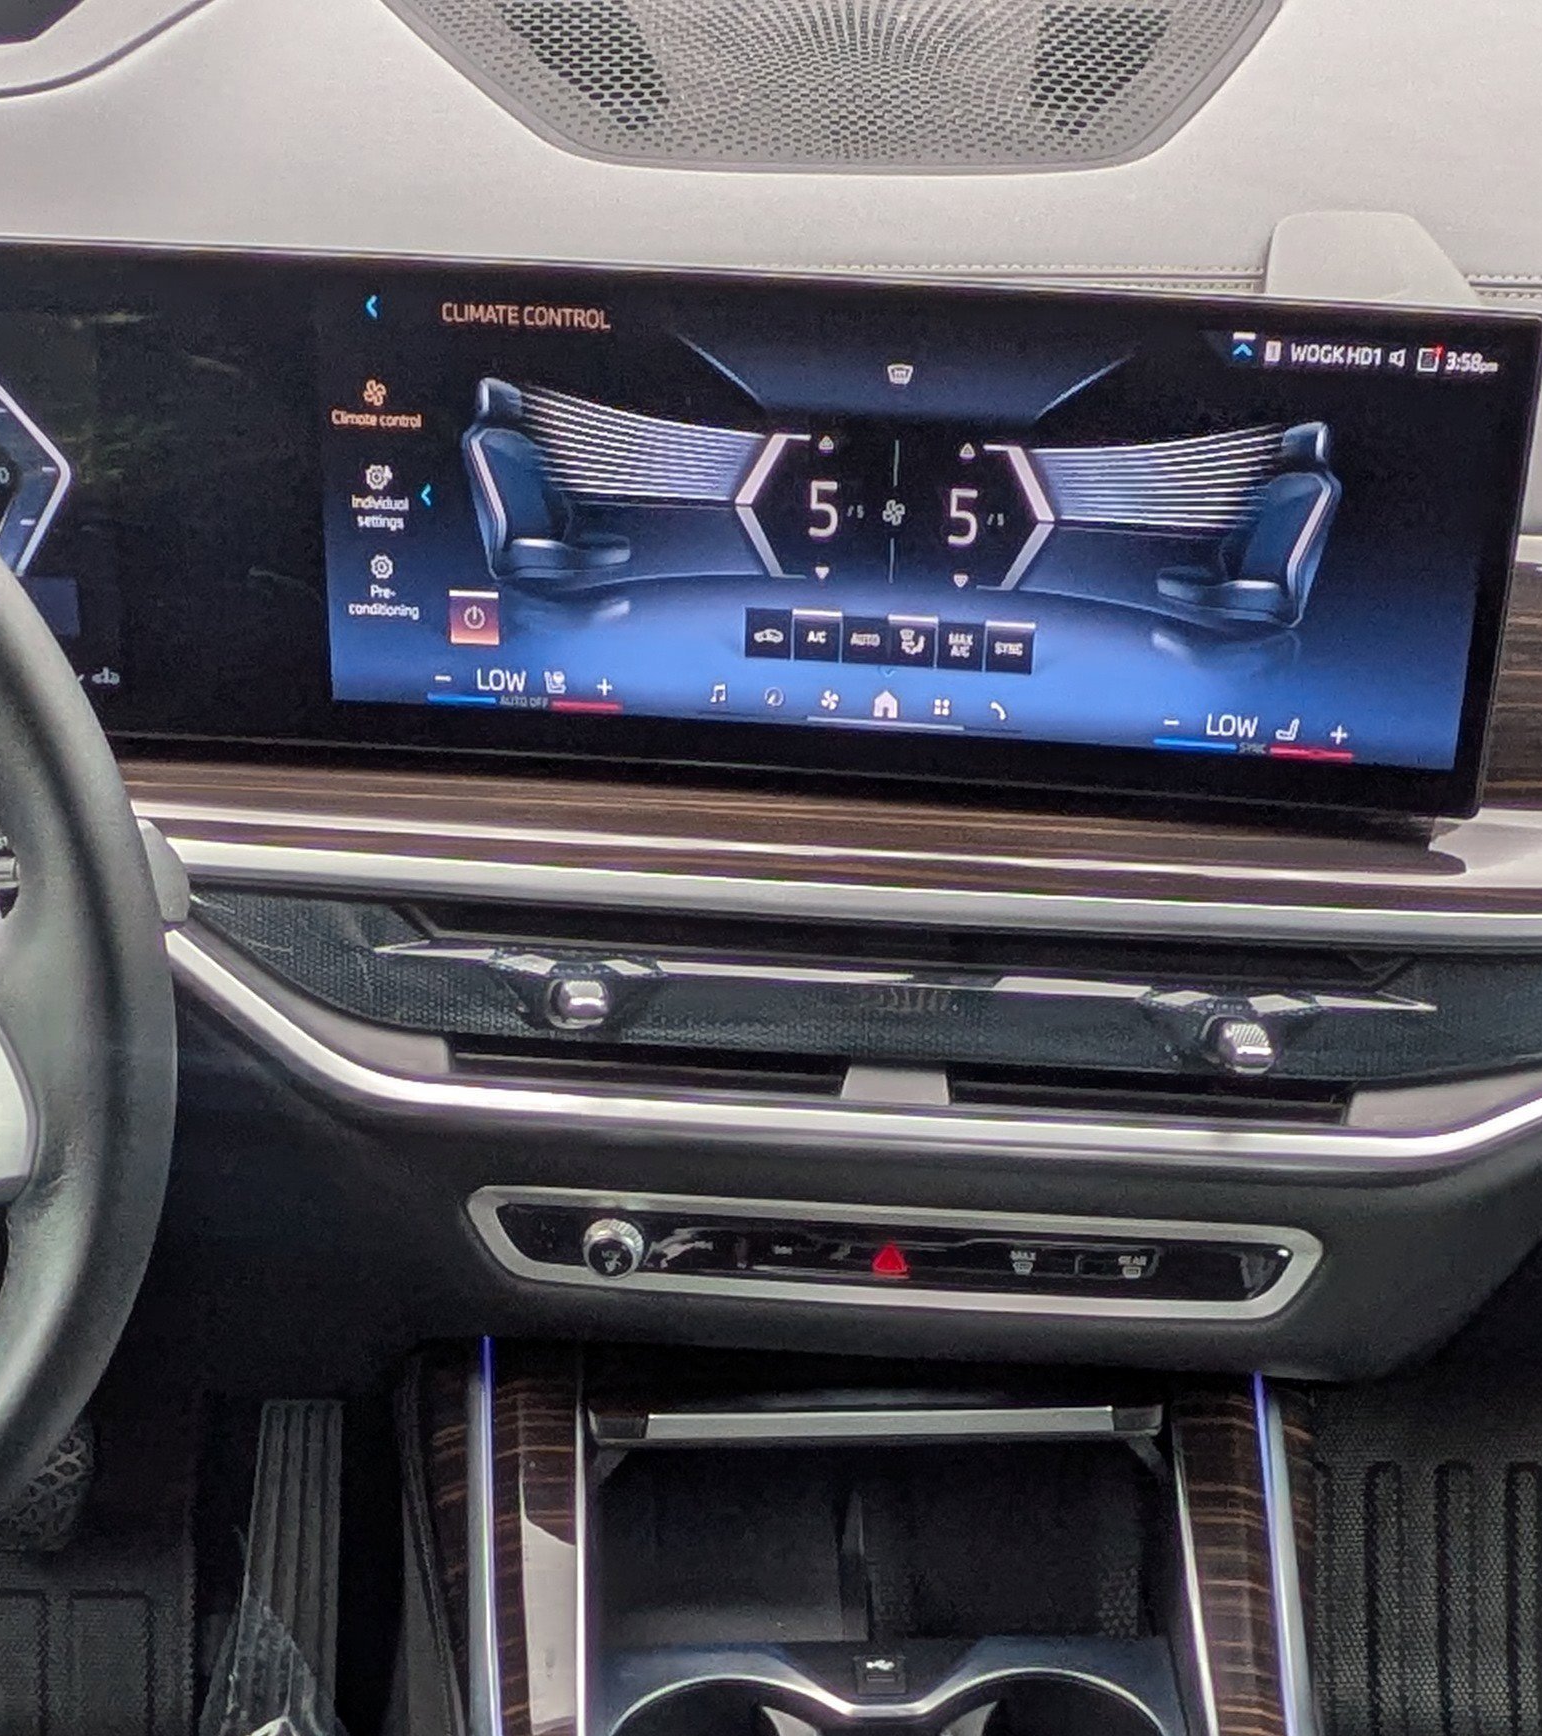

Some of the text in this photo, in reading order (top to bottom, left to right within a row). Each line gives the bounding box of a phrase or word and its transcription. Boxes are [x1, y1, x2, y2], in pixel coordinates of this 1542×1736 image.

[441, 302, 611, 330] CLIMATE CONTROL
[1291, 343, 1382, 366] WOGK HD1
[331, 410, 422, 428] Climate control
[351, 495, 409, 511] Individual
[808, 480, 838, 537] 5
[356, 514, 404, 531] settings
[948, 488, 978, 545] 5
[370, 584, 397, 599] Pre-
[348, 603, 420, 620] conditioning
[807, 630, 828, 643] A/C
[476, 668, 527, 692] LOW
[1206, 713, 1259, 739] LOW
